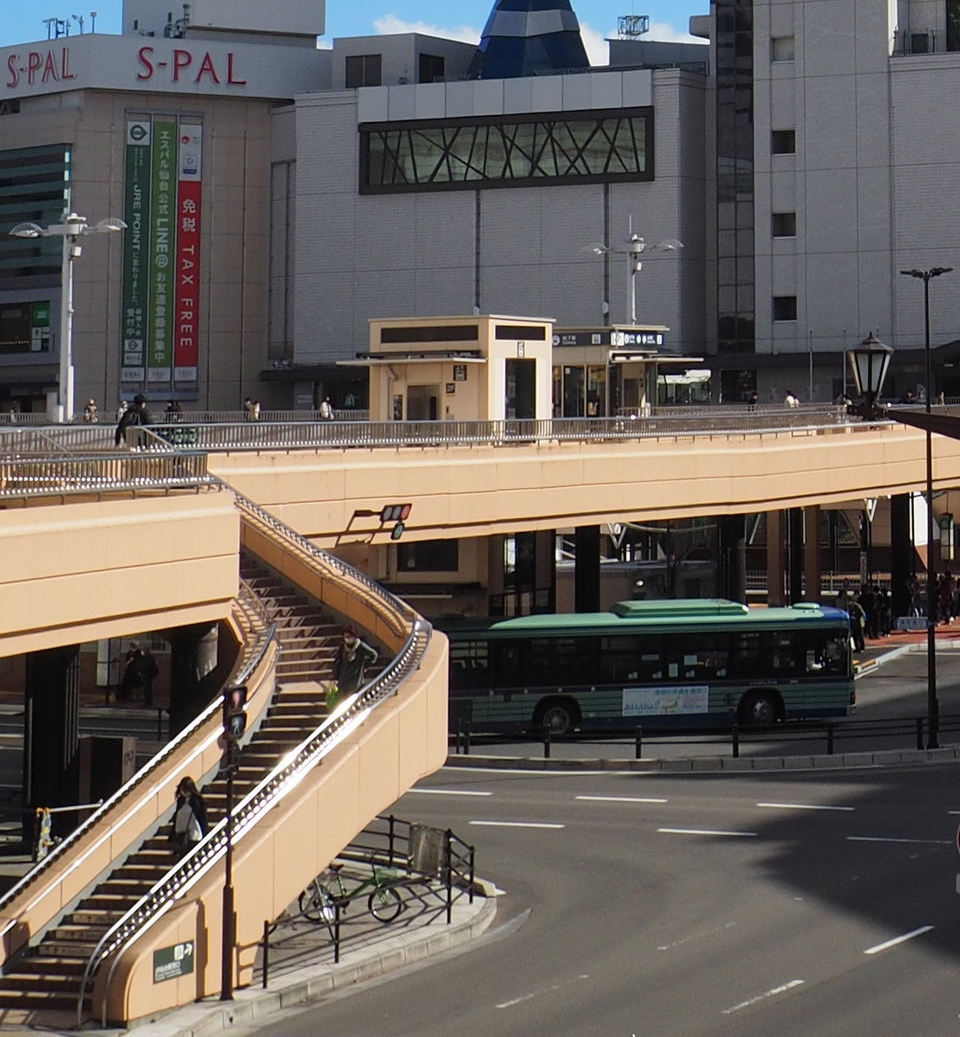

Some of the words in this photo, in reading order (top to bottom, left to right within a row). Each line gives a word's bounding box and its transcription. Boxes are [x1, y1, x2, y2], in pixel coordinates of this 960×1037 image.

[7, 47, 77, 88] S-PAL
[137, 46, 247, 85] S-PAL
[132, 184, 142, 209] JRE
[182, 199, 196, 232] 免税
[131, 212, 142, 250] POINT
[182, 245, 194, 284] TAX
[181, 298, 193, 346] FREE
